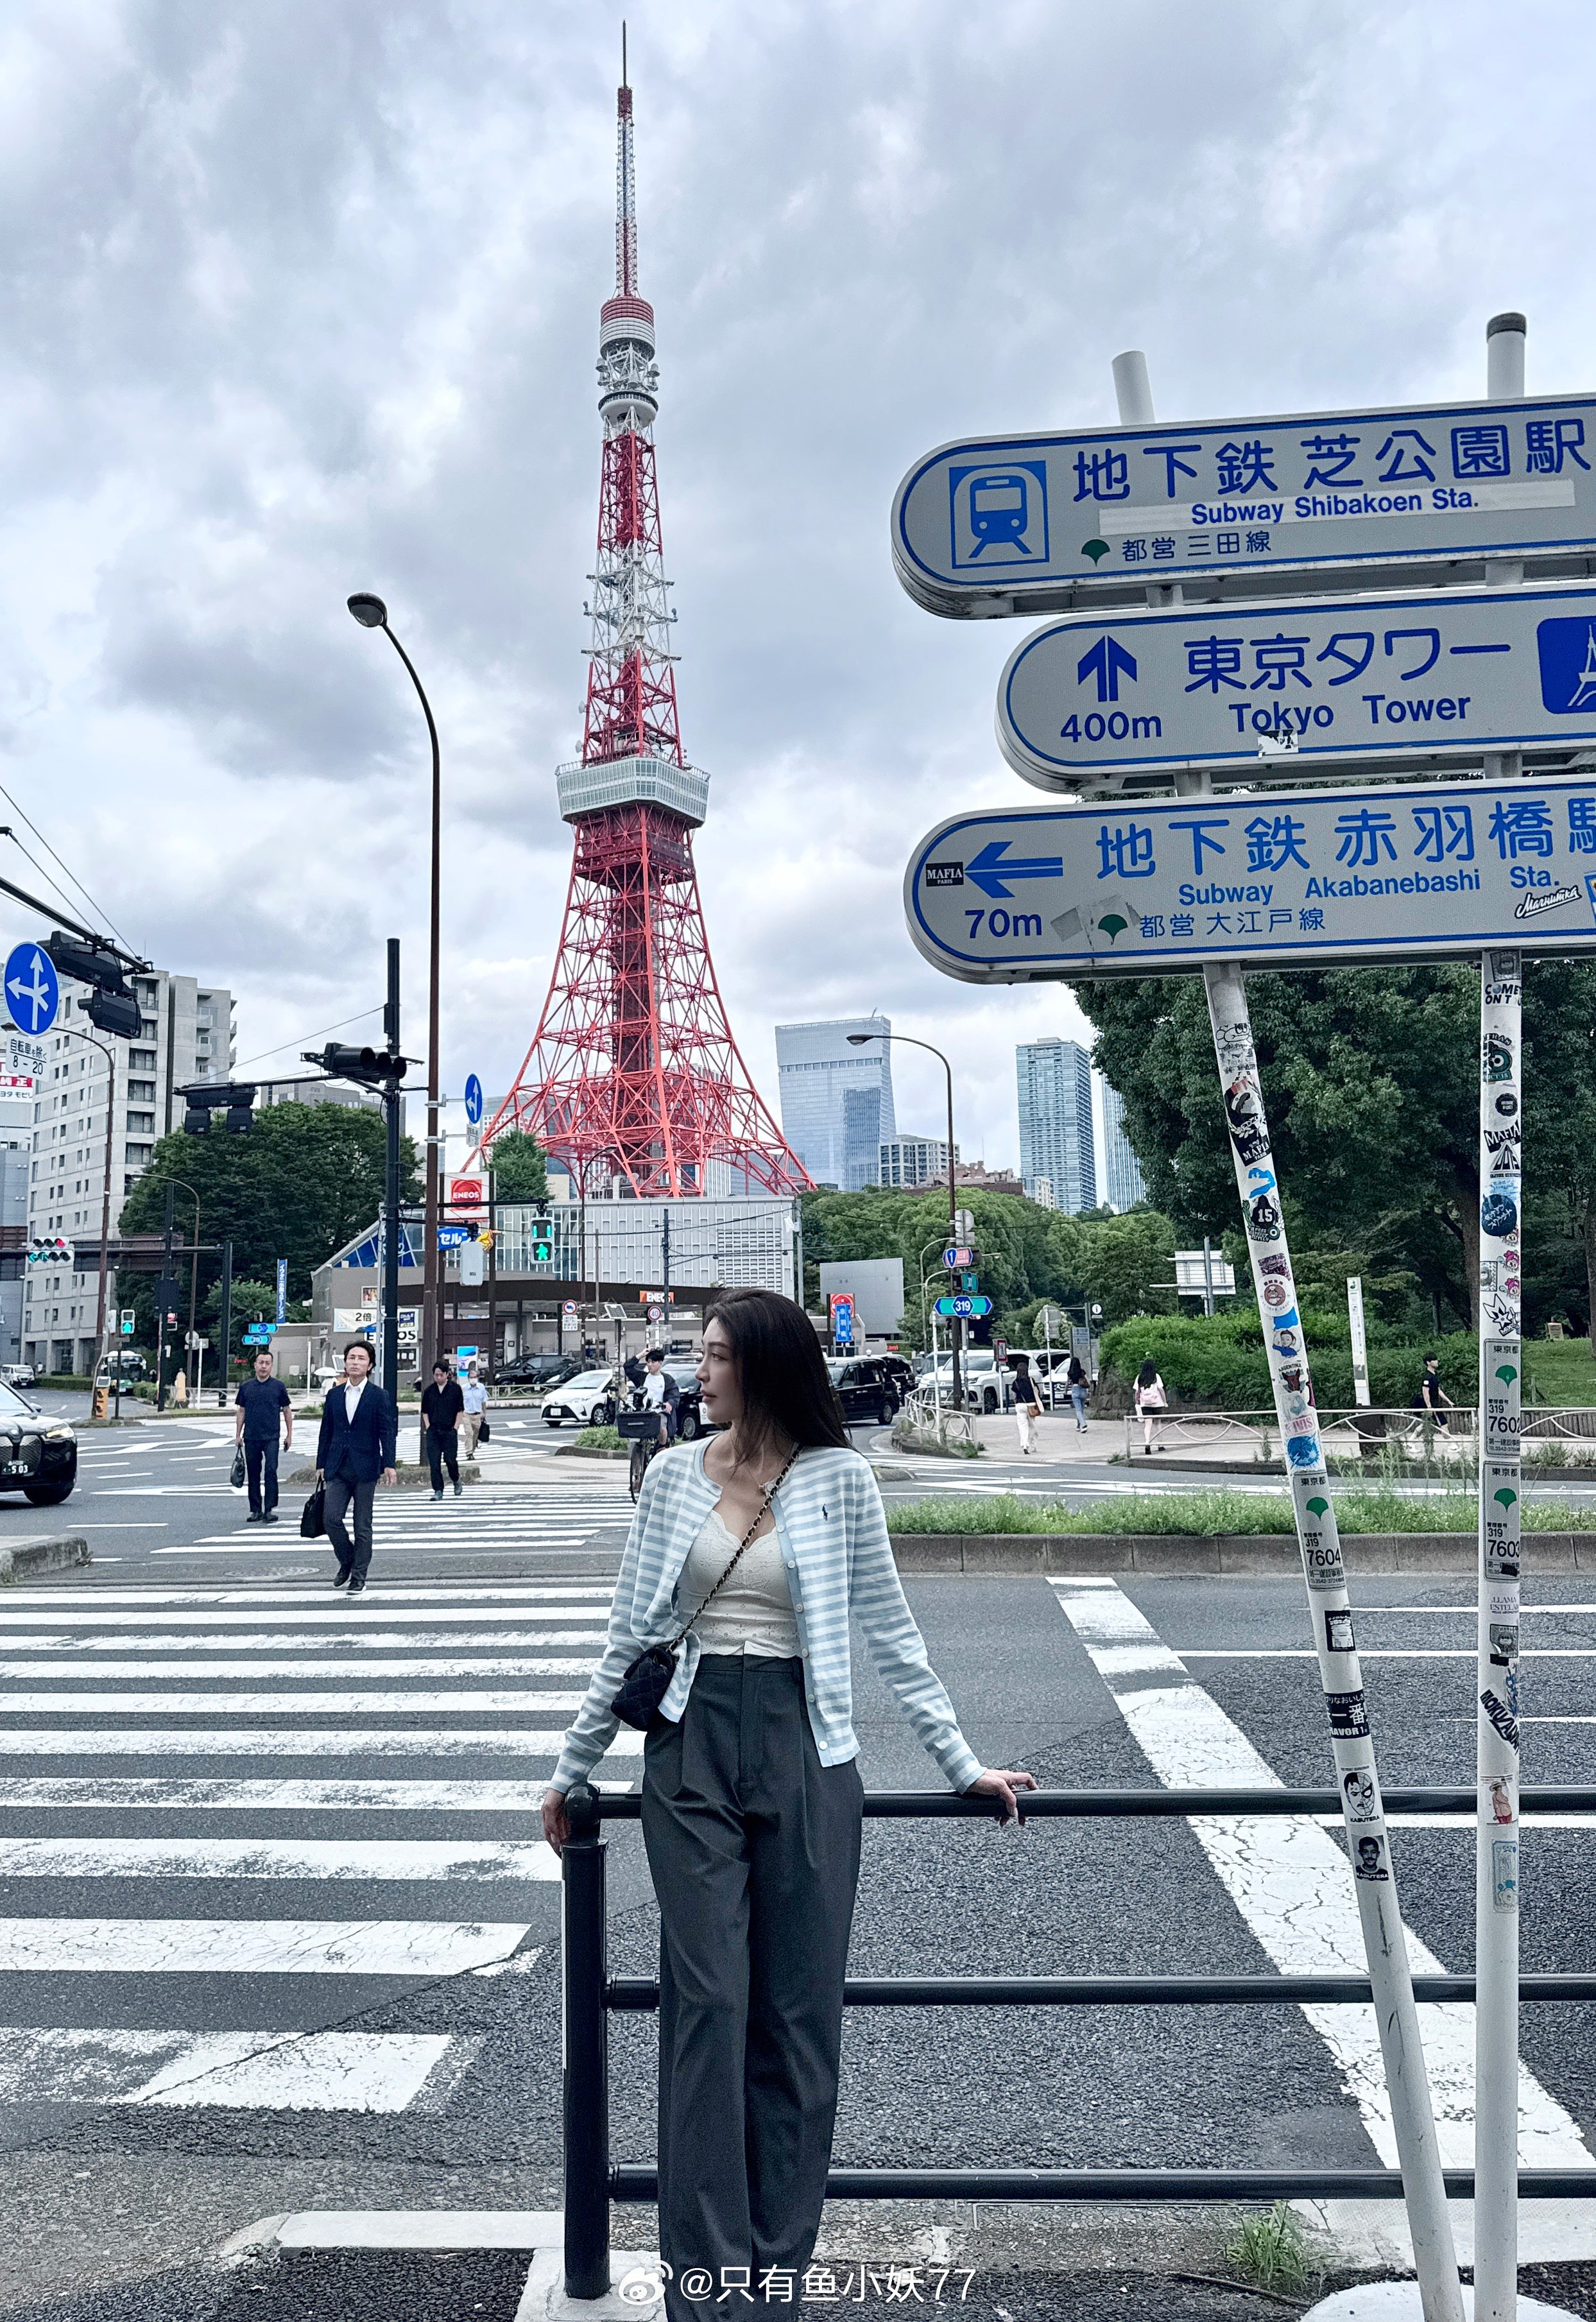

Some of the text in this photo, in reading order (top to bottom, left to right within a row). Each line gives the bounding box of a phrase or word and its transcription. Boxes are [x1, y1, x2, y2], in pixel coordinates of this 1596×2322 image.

[1192, 487, 1480, 526] Subway Shibakoen Sta.
[1184, 628, 1511, 694] 東京タワー
[1228, 694, 1470, 735] Tokyo Tower
[1060, 712, 1162, 743] 400m
[927, 867, 963, 880] MAFIA
[1179, 865, 1559, 906] Subway Akabanebashi Sta.
[965, 909, 1042, 938] 70m
[1484, 1124, 1520, 1146] MAFIA
[1242, 1142, 1269, 1161] MAFIA
[1258, 1208, 1273, 1223] 15
[949, 1251, 954, 1263] 1
[955, 1300, 971, 1312] 319
[1493, 1345, 1518, 1354] 東京都
[1489, 1404, 1504, 1413] 319
[1491, 1468, 1518, 1476] 東京都
[1301, 1476, 1326, 1486] 東京都
[1488, 1528, 1503, 1537] 319
[1305, 1538, 1319, 1547] 319
[1306, 1547, 1341, 1567] 7604
[1350, 1815, 1380, 1823] KASUTERA
